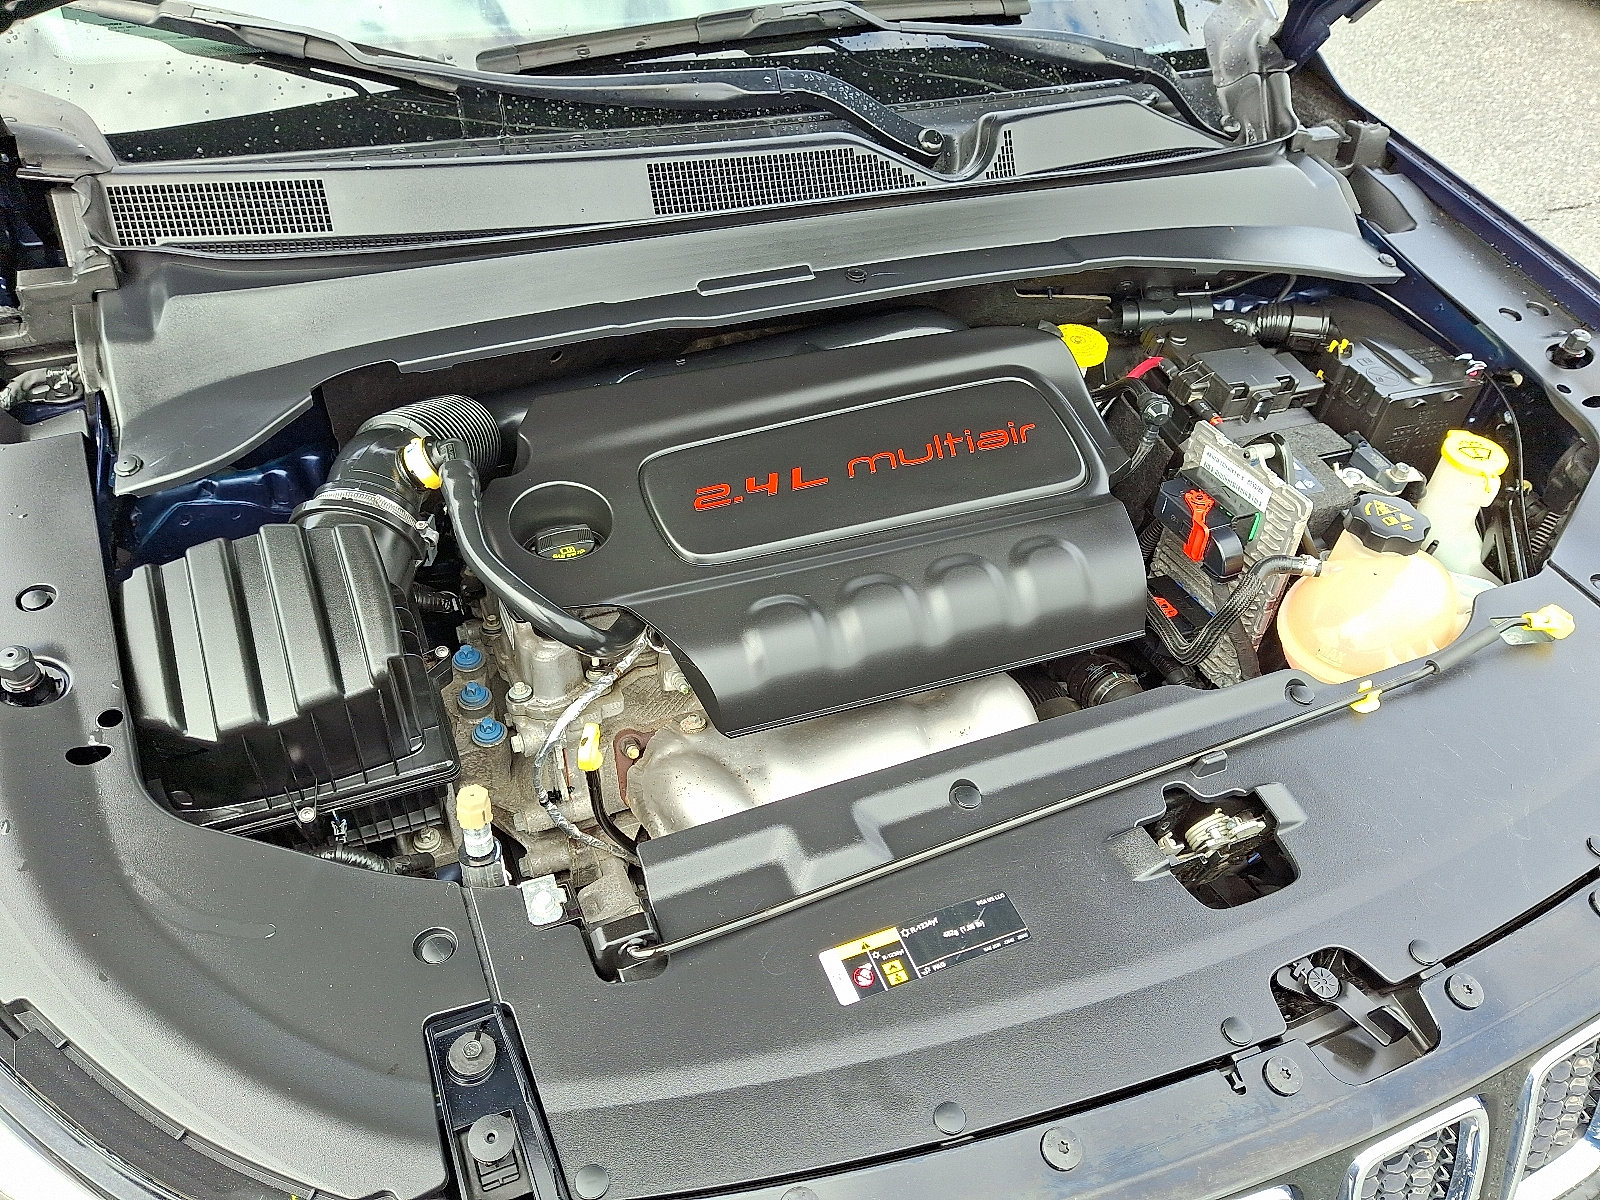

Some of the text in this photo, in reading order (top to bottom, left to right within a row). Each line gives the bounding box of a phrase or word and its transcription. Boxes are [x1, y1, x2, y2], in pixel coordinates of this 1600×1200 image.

[693, 421, 1035, 510] 2.4 L multiair
